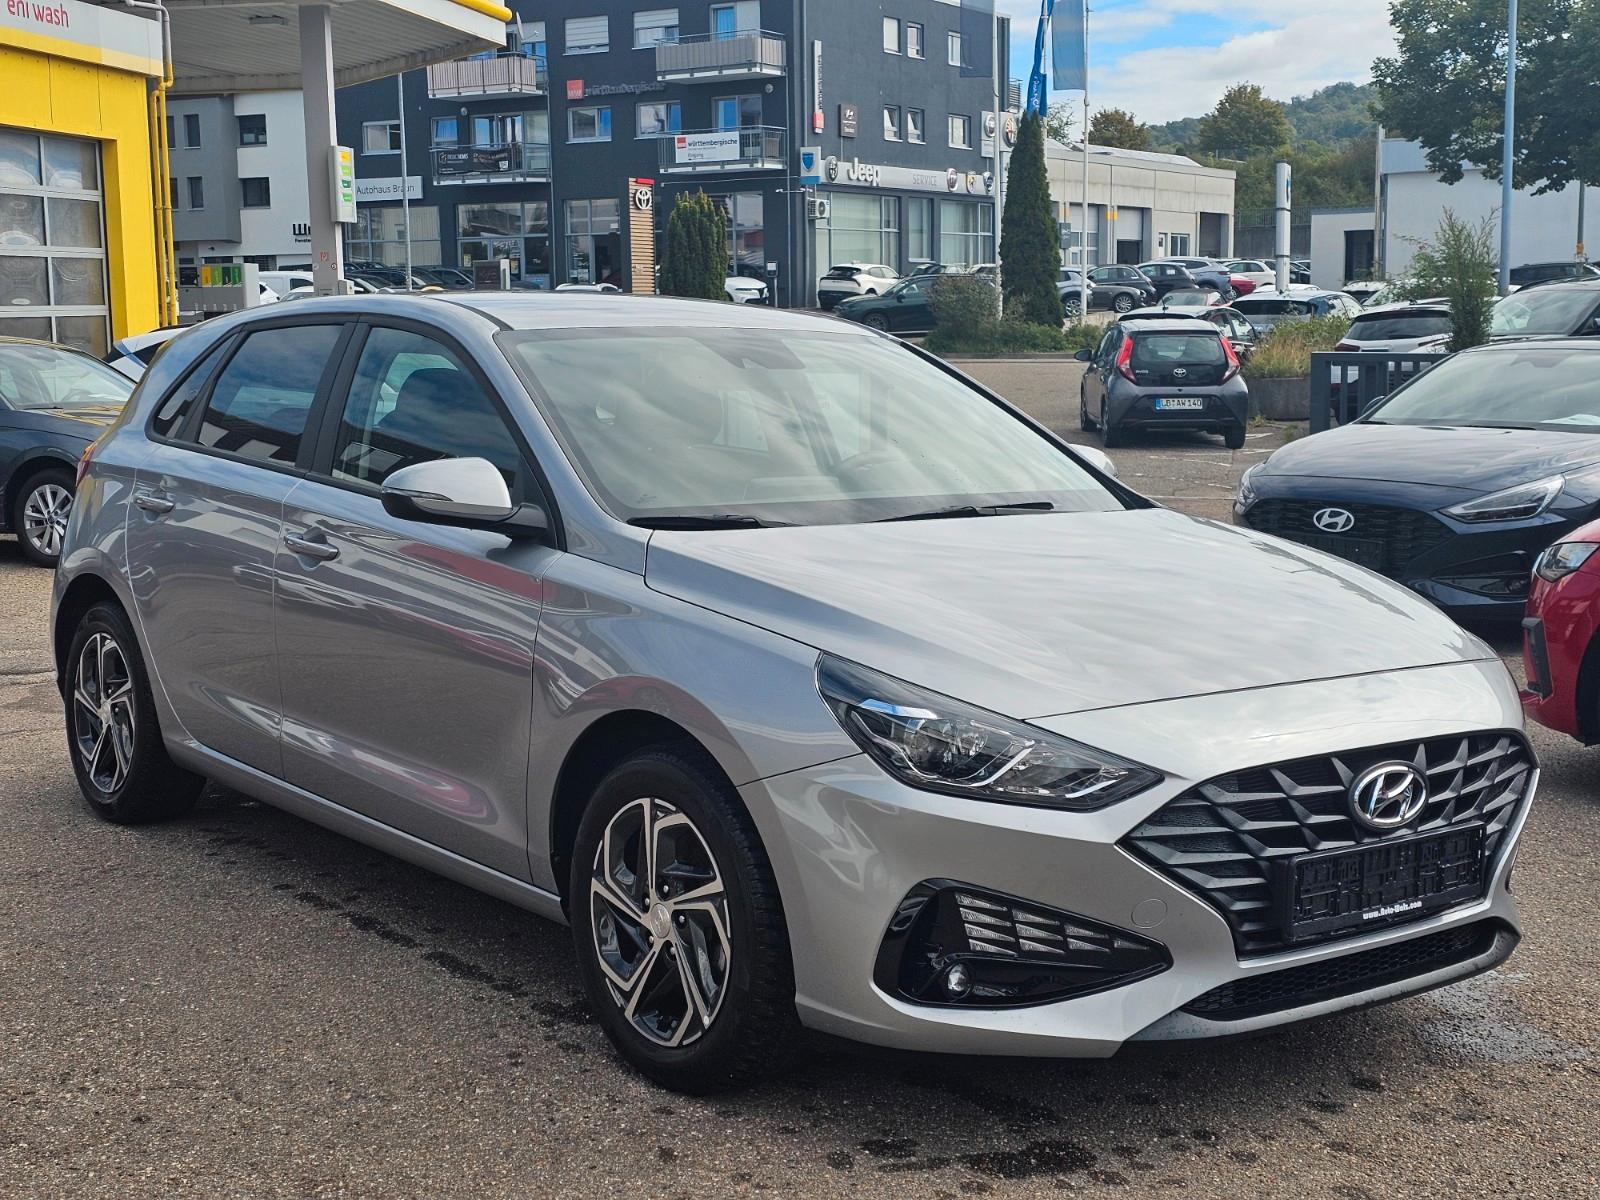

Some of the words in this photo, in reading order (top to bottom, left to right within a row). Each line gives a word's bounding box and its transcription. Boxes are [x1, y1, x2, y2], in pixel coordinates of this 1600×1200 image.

[7, 0, 30, 19] eni
[32, 3, 70, 28] wash
[847, 156, 881, 187] Jeep
[912, 174, 938, 187] SERVICE
[356, 184, 391, 196] Autohaus
[1176, 399, 1187, 407] AW
[1187, 399, 1202, 408] 140
